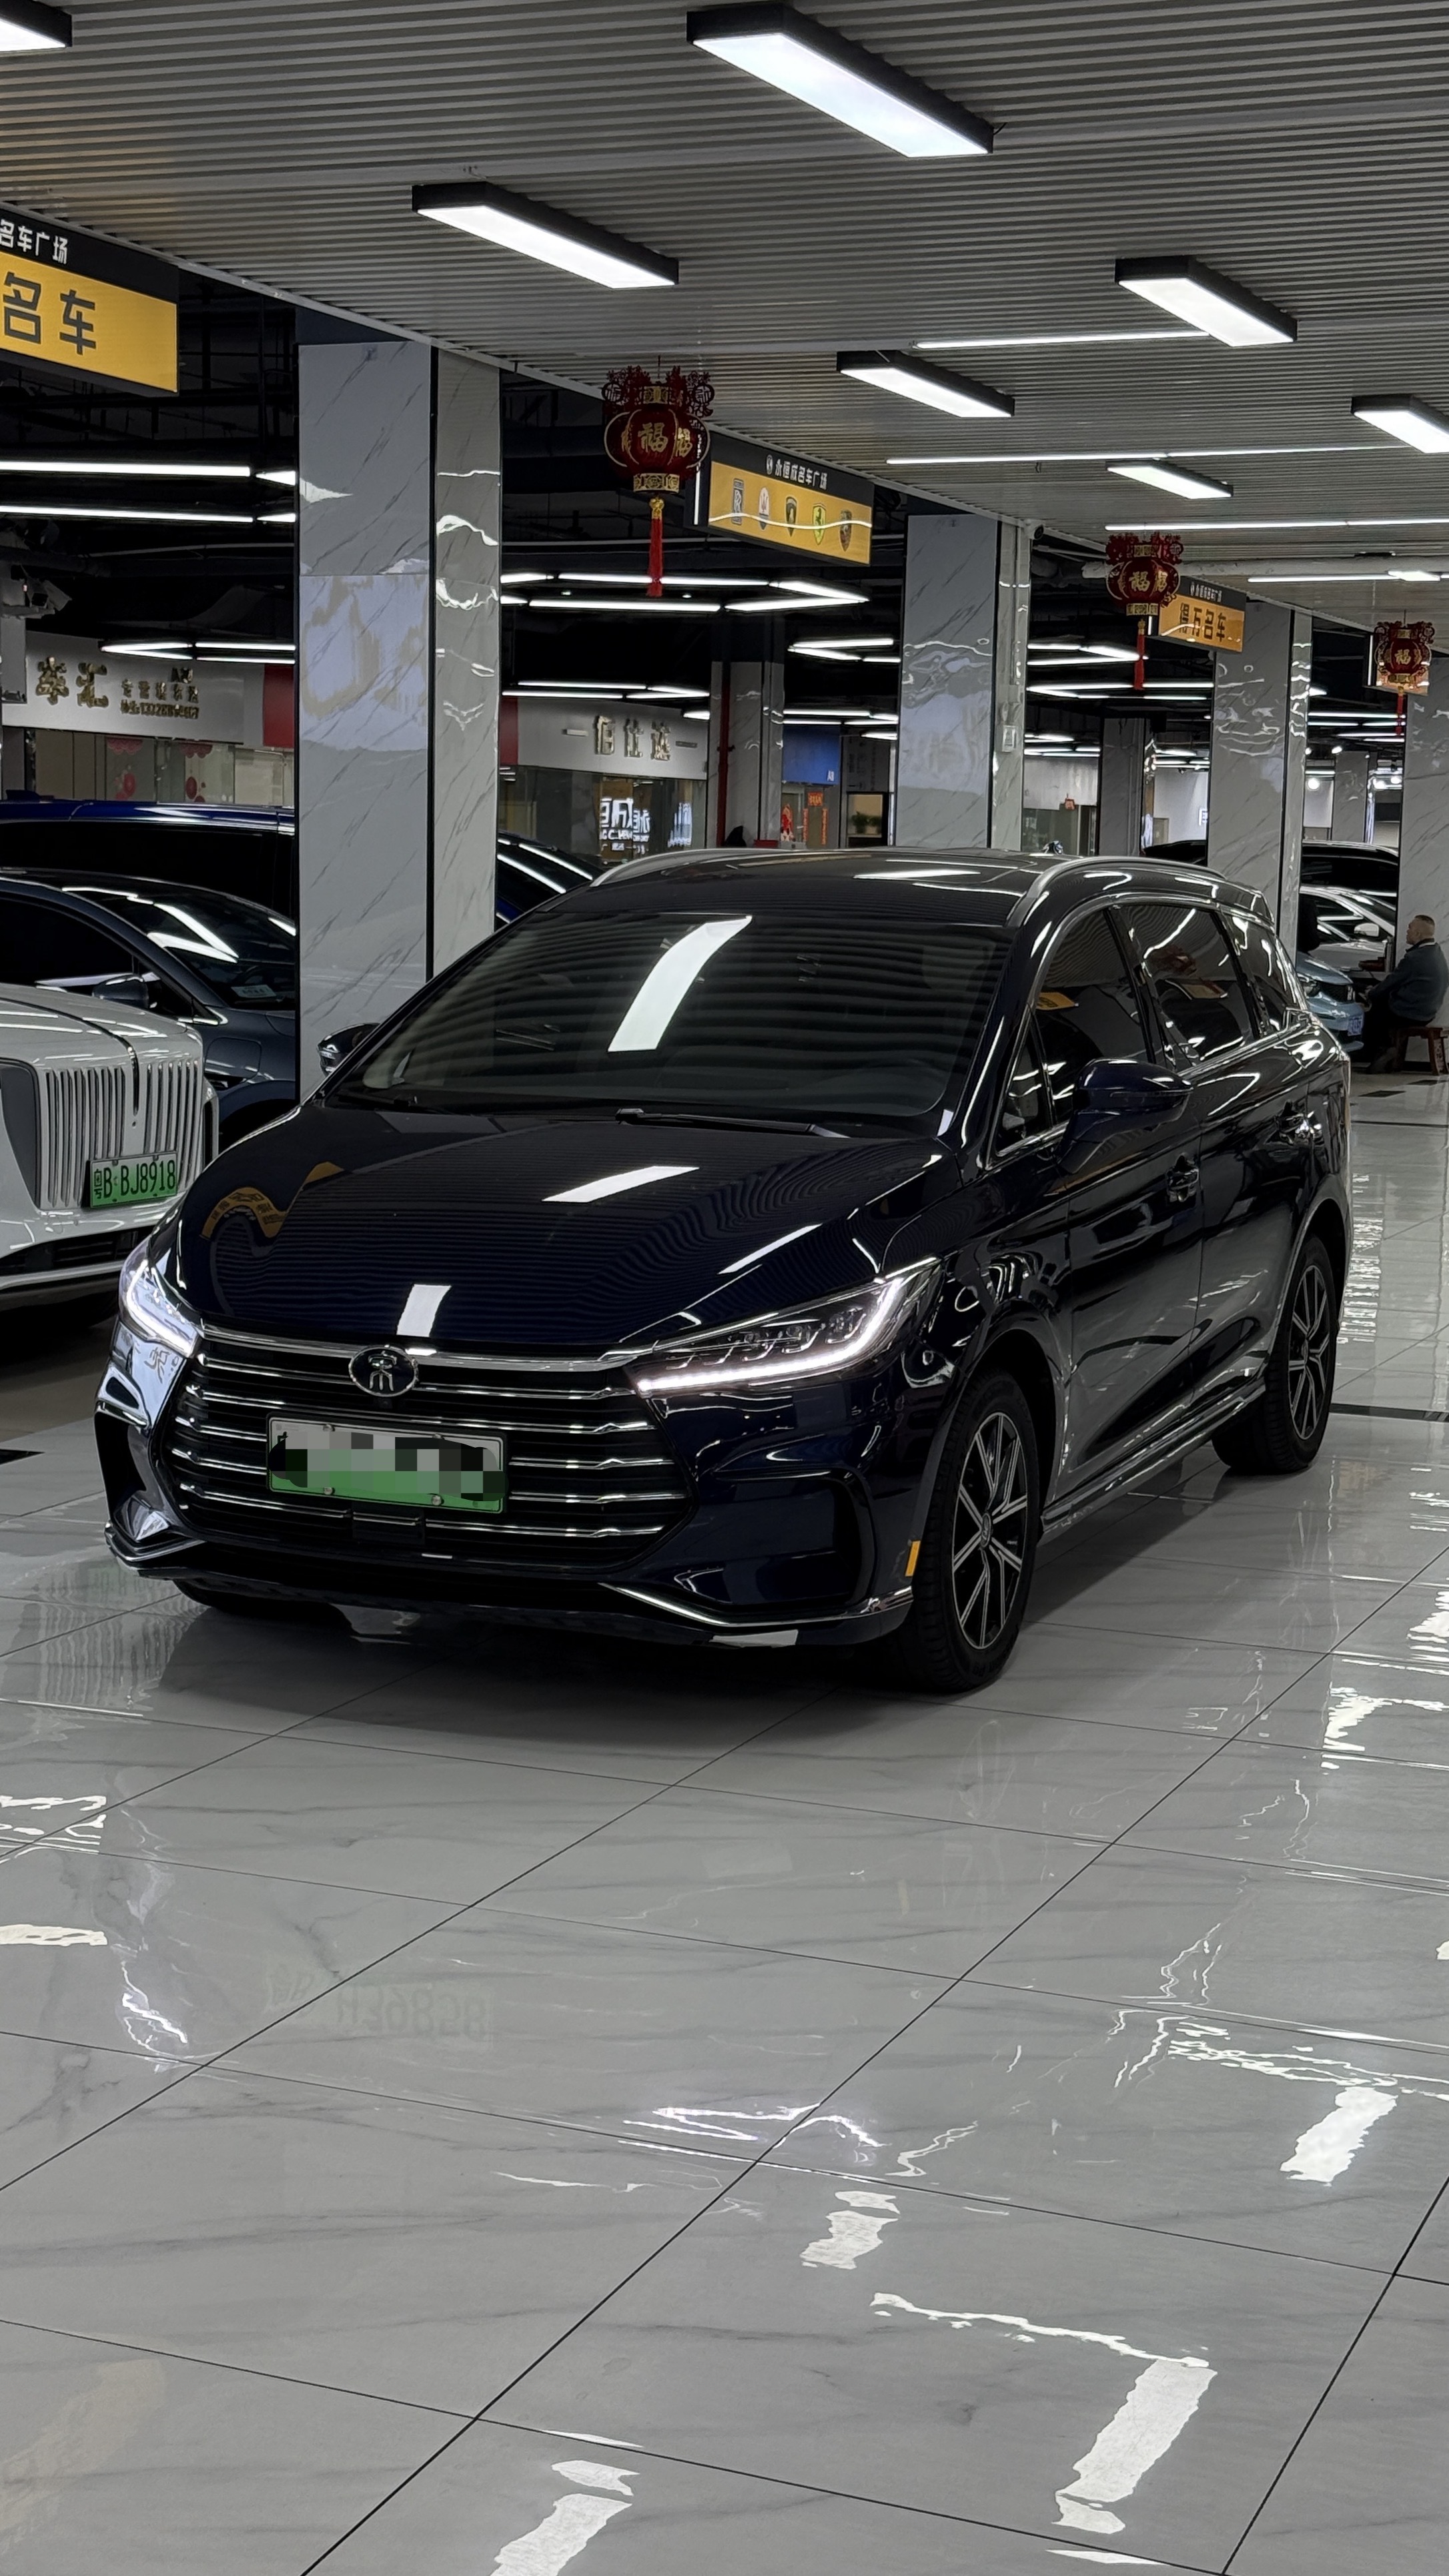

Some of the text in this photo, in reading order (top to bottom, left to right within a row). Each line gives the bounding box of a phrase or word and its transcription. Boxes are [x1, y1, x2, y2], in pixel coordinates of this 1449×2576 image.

[0, 219, 67, 264] 名车广场
[3, 271, 97, 356] 名车
[638, 422, 668, 453] 福
[1129, 570, 1150, 592] 福
[1394, 649, 1412, 665] 福
[120, 1160, 176, 1196] BJ8918
